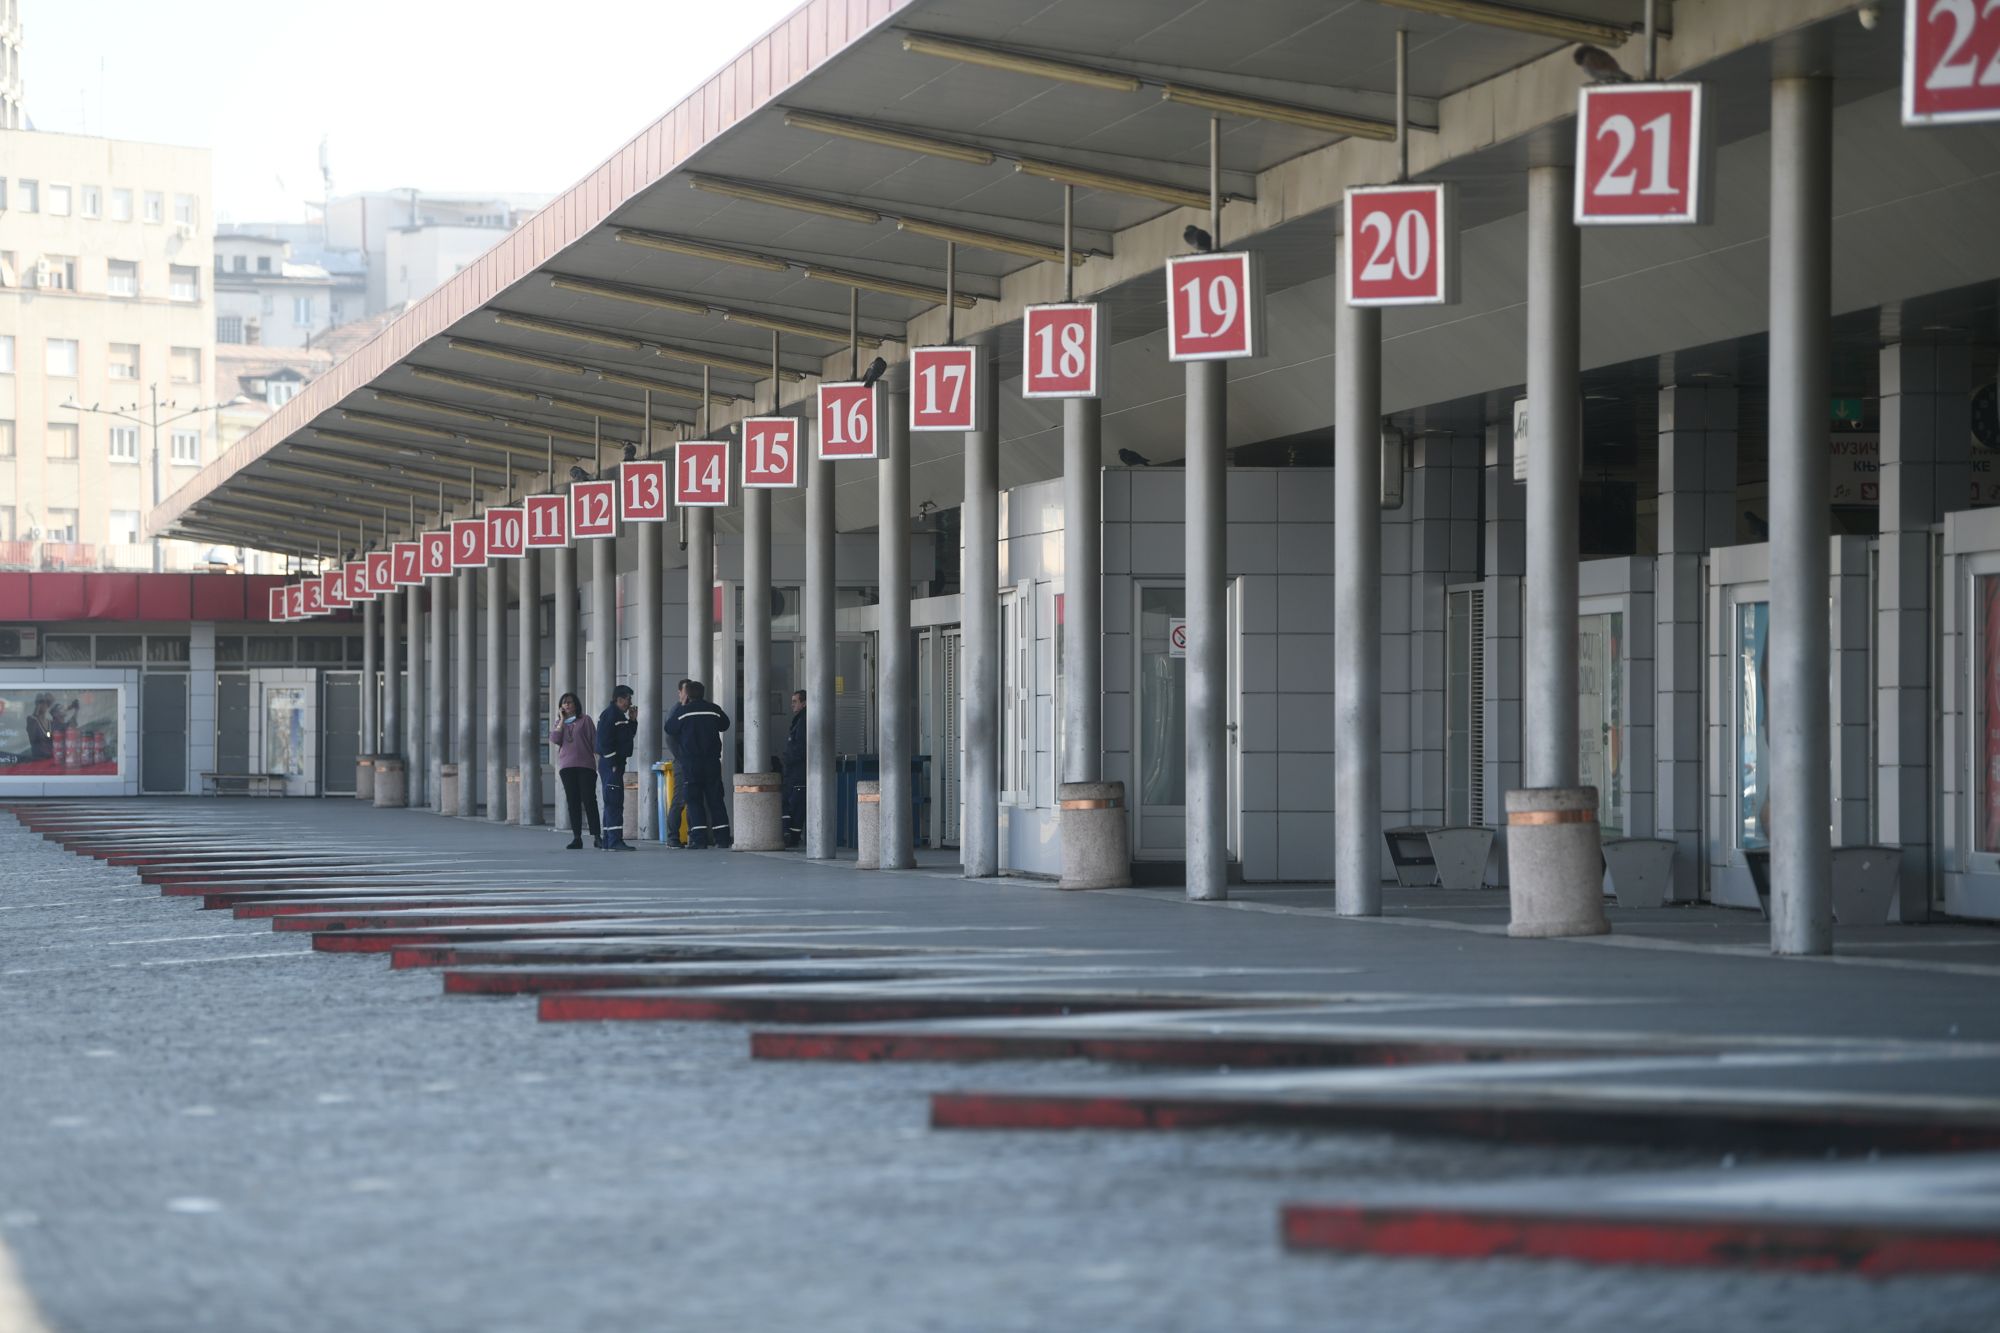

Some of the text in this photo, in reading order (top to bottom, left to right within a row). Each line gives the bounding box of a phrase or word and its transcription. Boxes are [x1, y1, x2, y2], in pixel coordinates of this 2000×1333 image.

[1594, 114, 1679, 195] 21
[1360, 210, 1429, 280] 20
[1181, 276, 1237, 338] 19
[1035, 323, 1085, 378] 18
[920, 365, 966, 413] 17
[827, 398, 867, 443] 16
[751, 432, 788, 473] 15
[1853, 460, 1991, 472] КЊ КЕ
[684, 455, 720, 492] 14
[628, 474, 659, 509] 13
[532, 506, 561, 537] 11
[579, 493, 609, 526] 12
[463, 530, 475, 557] 9
[492, 519, 519, 548] 10
[403, 551, 415, 575] 7
[432, 541, 443, 567] 8
[354, 569, 366, 593] 5
[376, 560, 387, 584] 6
[293, 592, 302, 613] 2
[310, 586, 321, 608] 3
[332, 578, 343, 600] 4
[280, 597, 286, 615] 1
